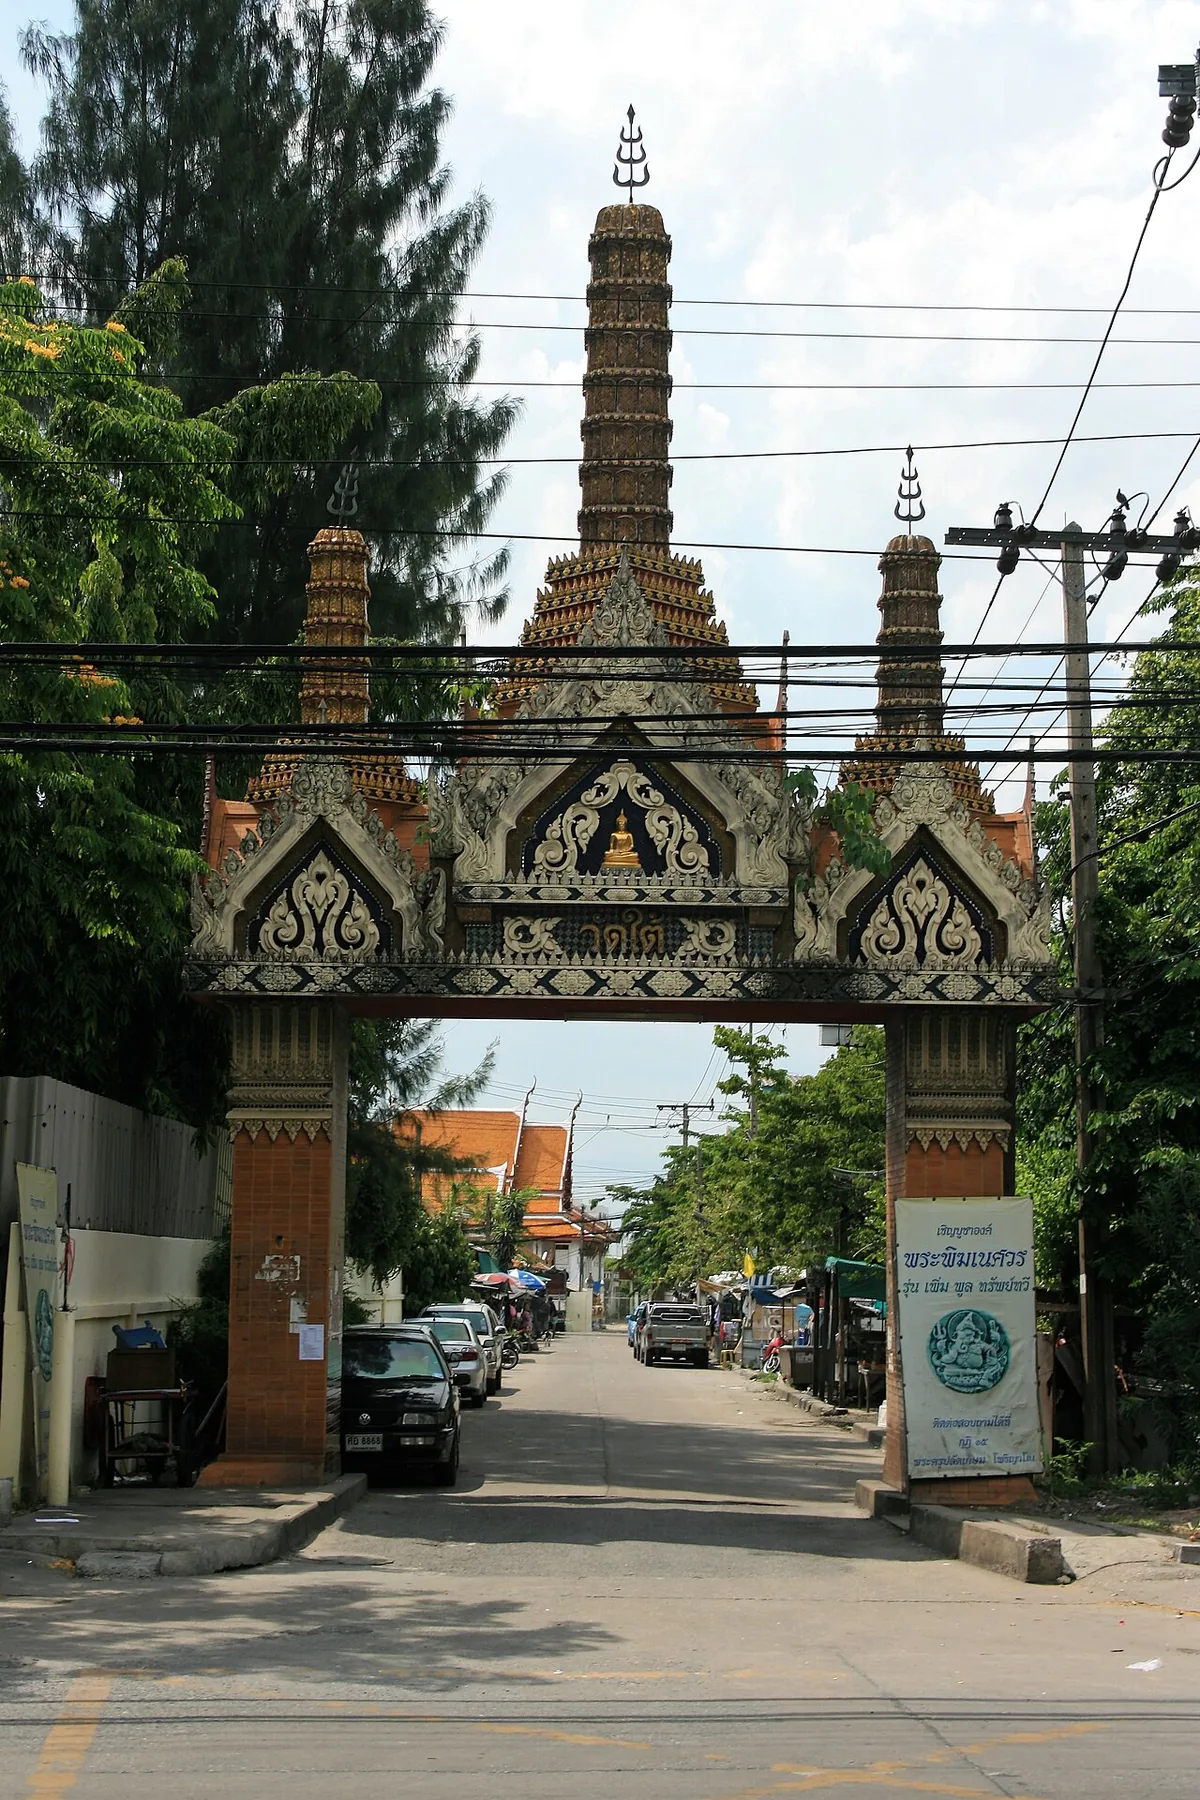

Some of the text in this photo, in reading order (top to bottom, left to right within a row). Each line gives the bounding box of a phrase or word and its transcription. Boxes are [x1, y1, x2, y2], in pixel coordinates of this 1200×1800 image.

[579, 908, 665, 954] วัดใต้
[937, 1223, 993, 1239] เชิญบูชาองค์
[903, 1246, 1028, 1268] พระพิฆเนศวร
[902, 1276, 1031, 1299] รุ่น เพิ่ม พูล ทรัพย์ทวี
[932, 1413, 1013, 1429] ติดต่อสอบถามได้ที่
